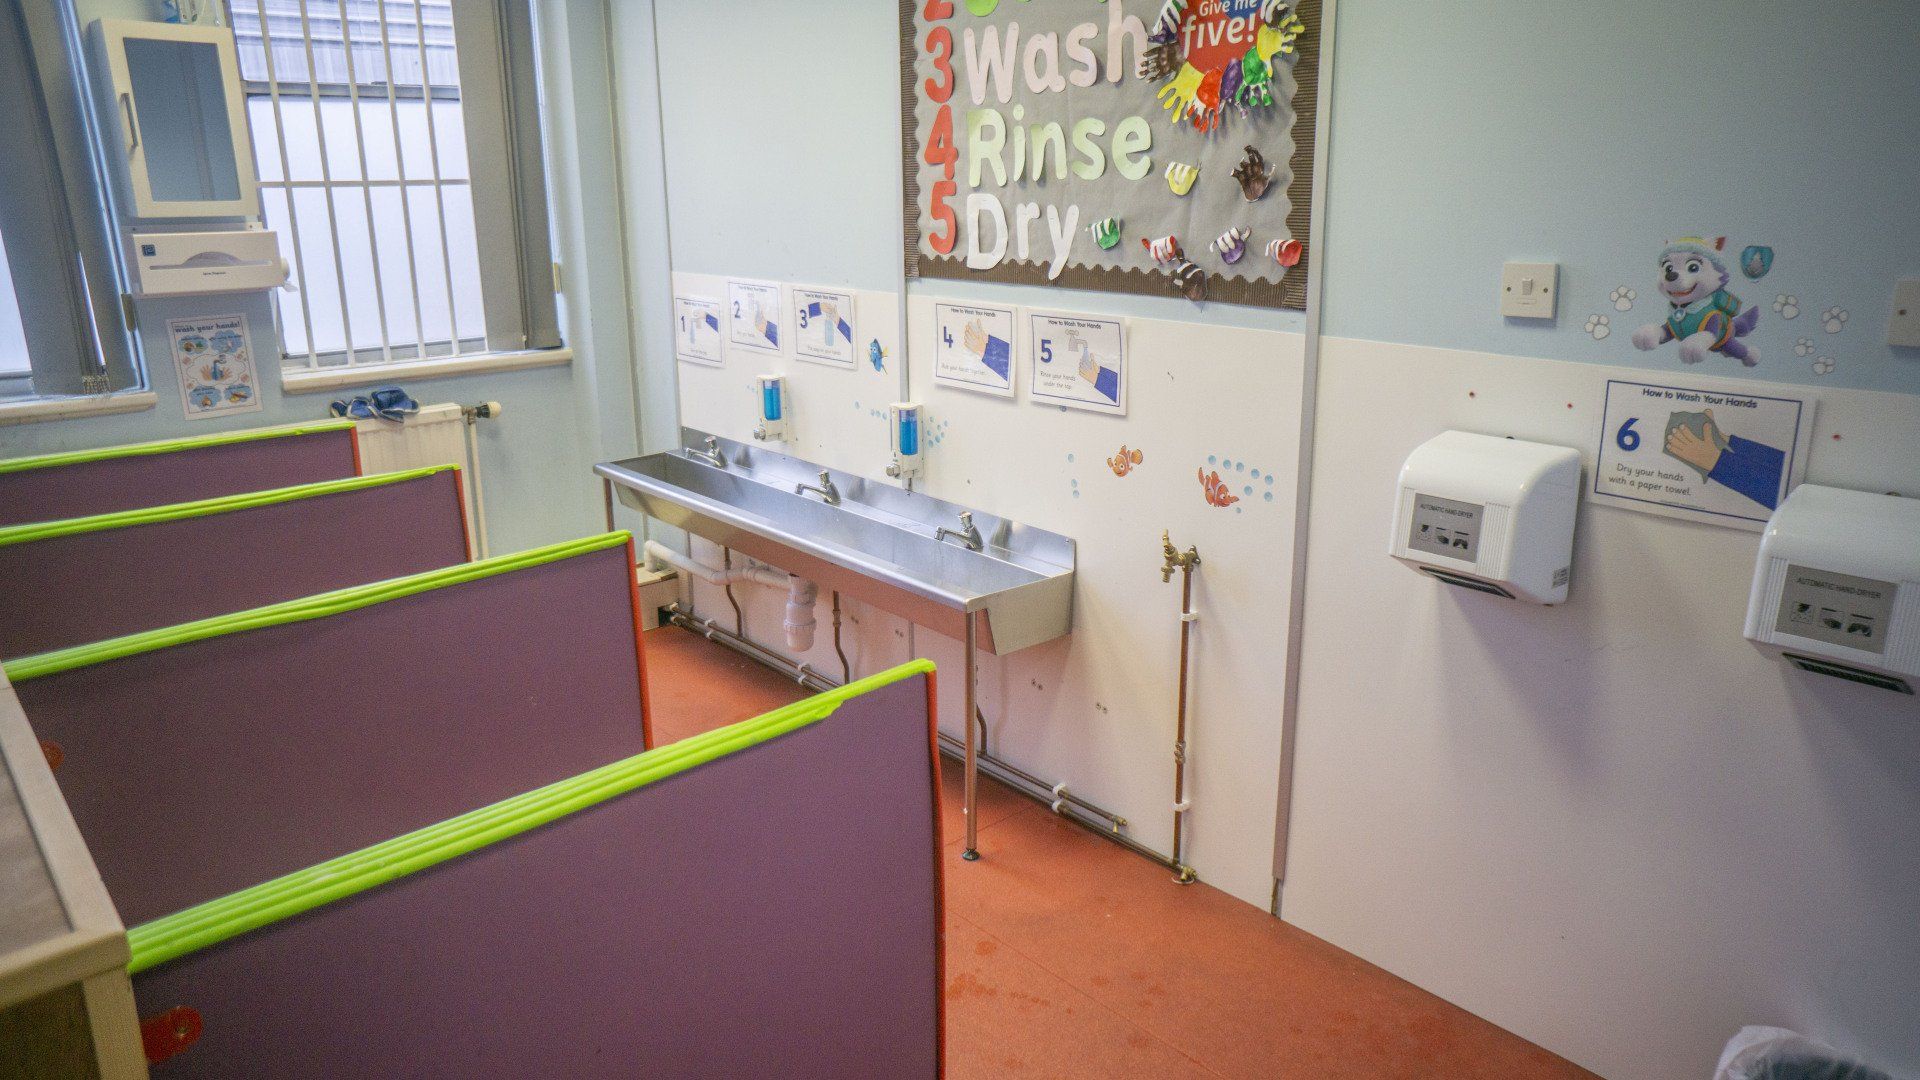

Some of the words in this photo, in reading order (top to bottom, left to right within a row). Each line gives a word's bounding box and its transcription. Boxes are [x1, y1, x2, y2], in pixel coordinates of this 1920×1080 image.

[1198, 0, 1230, 17] Give
[1234, 0, 1258, 11] me
[1181, 13, 1257, 59] five!
[924, 25, 954, 104] 3
[963, 0, 1149, 105] Wash
[924, 104, 958, 180] 4
[966, 104, 1152, 188] Rinse
[928, 180, 957, 255] 5
[966, 193, 1080, 280] Dry
[733, 300, 741, 319] 2
[800, 309, 808, 329] 3
[943, 326, 953, 348] 4
[1041, 339, 1053, 363] 5
[1642, 388, 1663, 398] How
[1665, 390, 1673, 399] to
[1675, 392, 1700, 403] Wash
[1703, 394, 1724, 405] Your
[1725, 397, 1758, 409] Hands
[1616, 417, 1641, 451] 6
[1608, 475, 1626, 485] with
[1637, 481, 1662, 492] paper
[1616, 463, 1633, 476] Dry
[1635, 468, 1655, 477] your
[1657, 470, 1684, 482] hands
